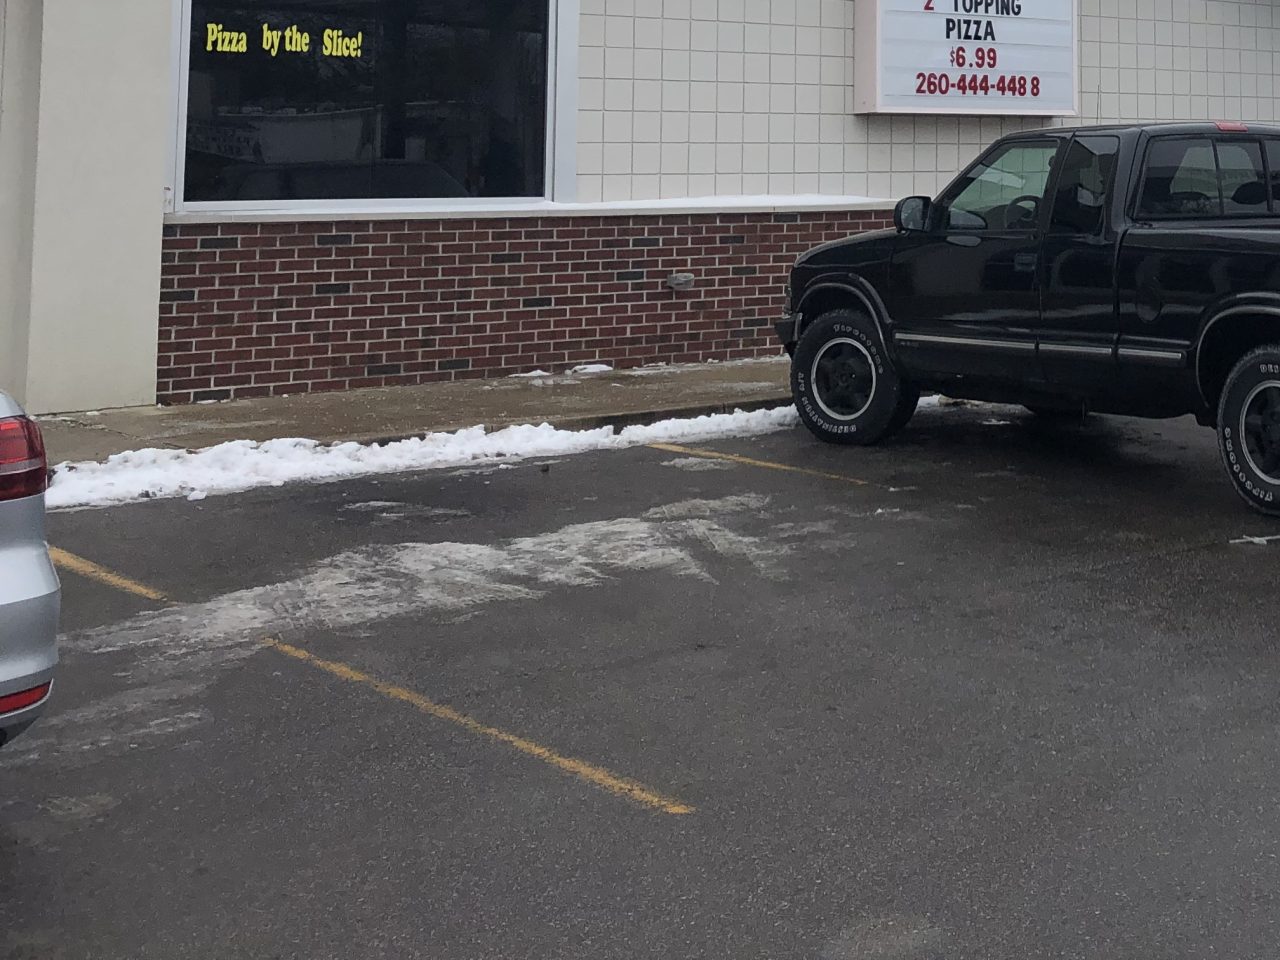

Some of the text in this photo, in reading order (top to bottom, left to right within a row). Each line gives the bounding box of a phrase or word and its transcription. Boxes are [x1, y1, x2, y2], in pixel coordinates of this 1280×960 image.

[205, 23, 363, 58] Pizza by the Slice!
[945, 18, 996, 41] PIZZA
[949, 46, 998, 69] $6.99
[915, 72, 1041, 97] 260-444-4488
